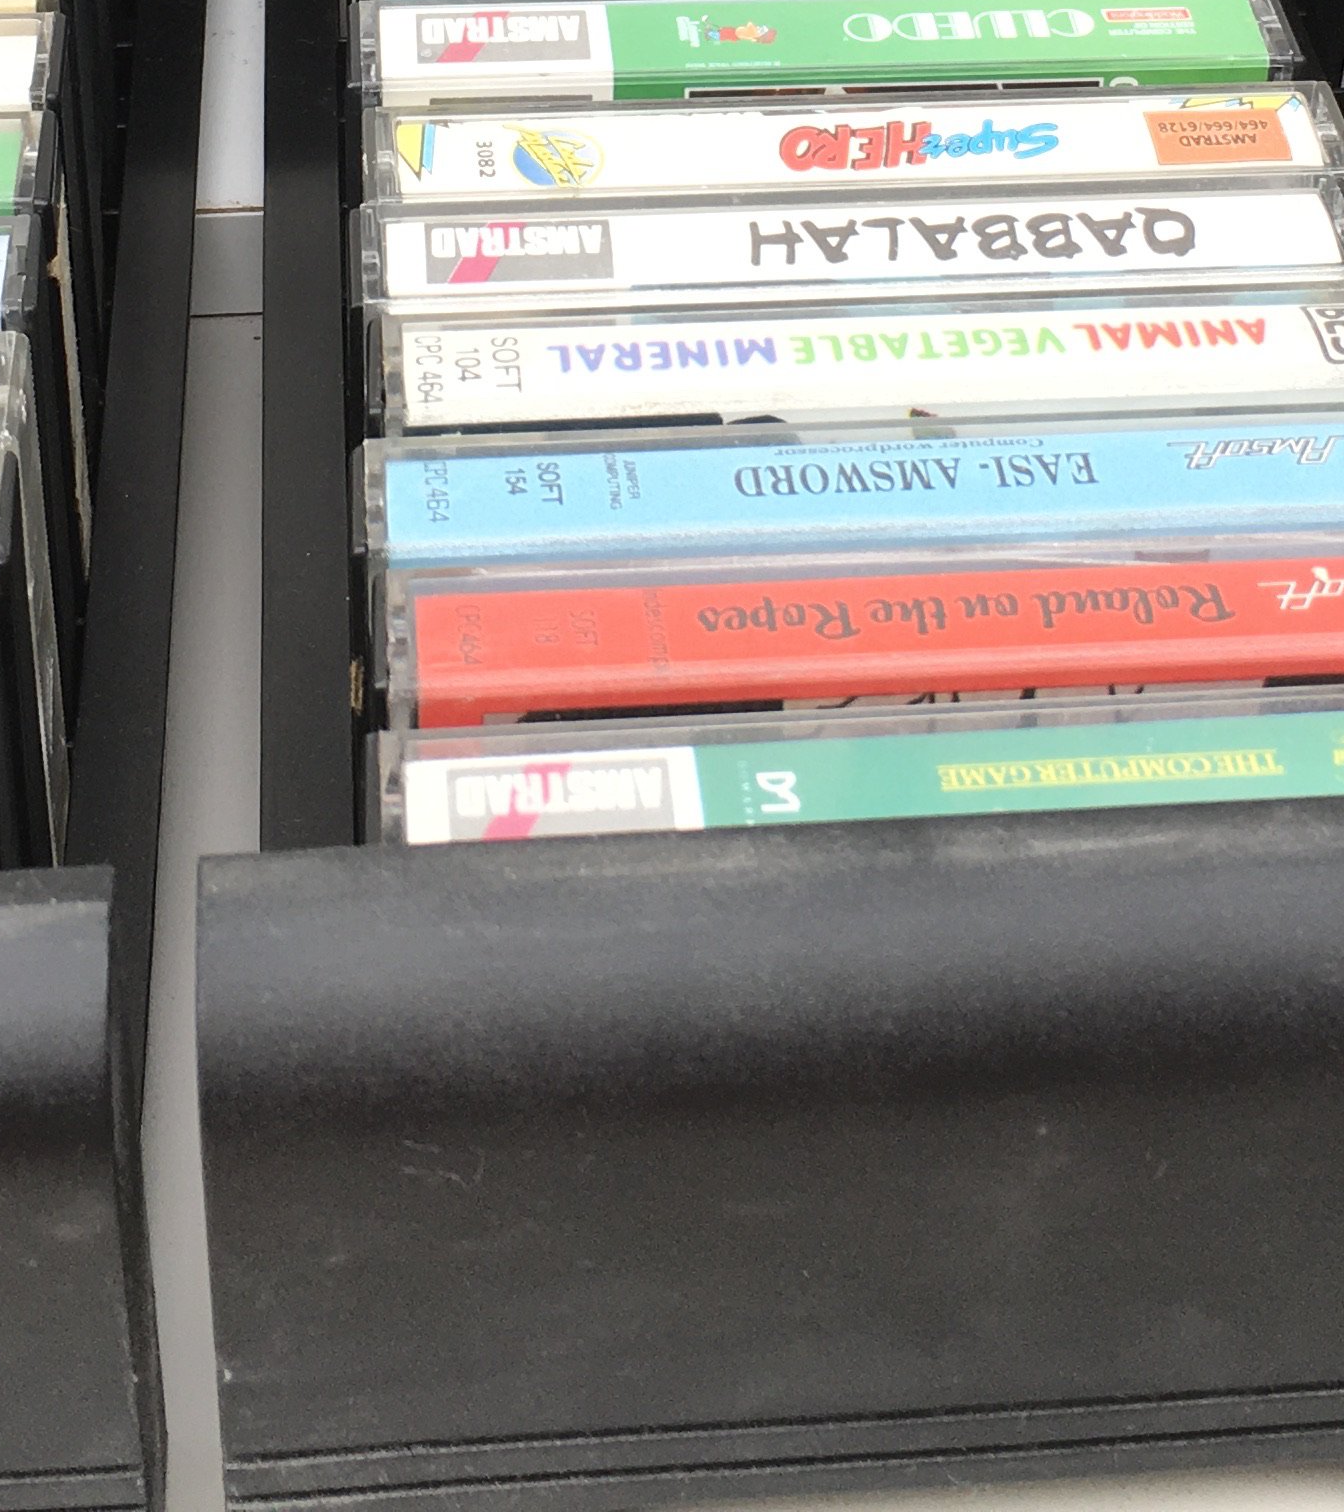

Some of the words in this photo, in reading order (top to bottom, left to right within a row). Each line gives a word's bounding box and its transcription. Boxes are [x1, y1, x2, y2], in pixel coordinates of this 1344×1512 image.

[423, 15, 583, 43] AMSTRAD
[846, 9, 1094, 38] CLUEDO
[476, 142, 495, 178] 3082
[782, 123, 926, 170] HERO
[432, 222, 603, 258] AMSTRAD
[747, 207, 1196, 267] QABBALAH
[414, 336, 443, 365] CPC
[546, 338, 778, 372] MINERAL
[791, 328, 1065, 367] VEGETABLE
[1075, 317, 1269, 355] ANIMAL
[455, 348, 482, 382] 104
[491, 337, 521, 393] SOFT
[416, 372, 444, 405] 464
[732, 460, 962, 498] AMSWORD
[976, 452, 1097, 490] EASI-
[696, 598, 862, 640] Ropes
[864, 596, 948, 636] the
[960, 593, 1019, 631] on
[1030, 584, 1236, 628] Roland
[936, 766, 1029, 790] GAME
[1031, 755, 1216, 783] COMPUTER
[1217, 750, 1285, 776] THE
[454, 769, 664, 814] AMSTRAD
